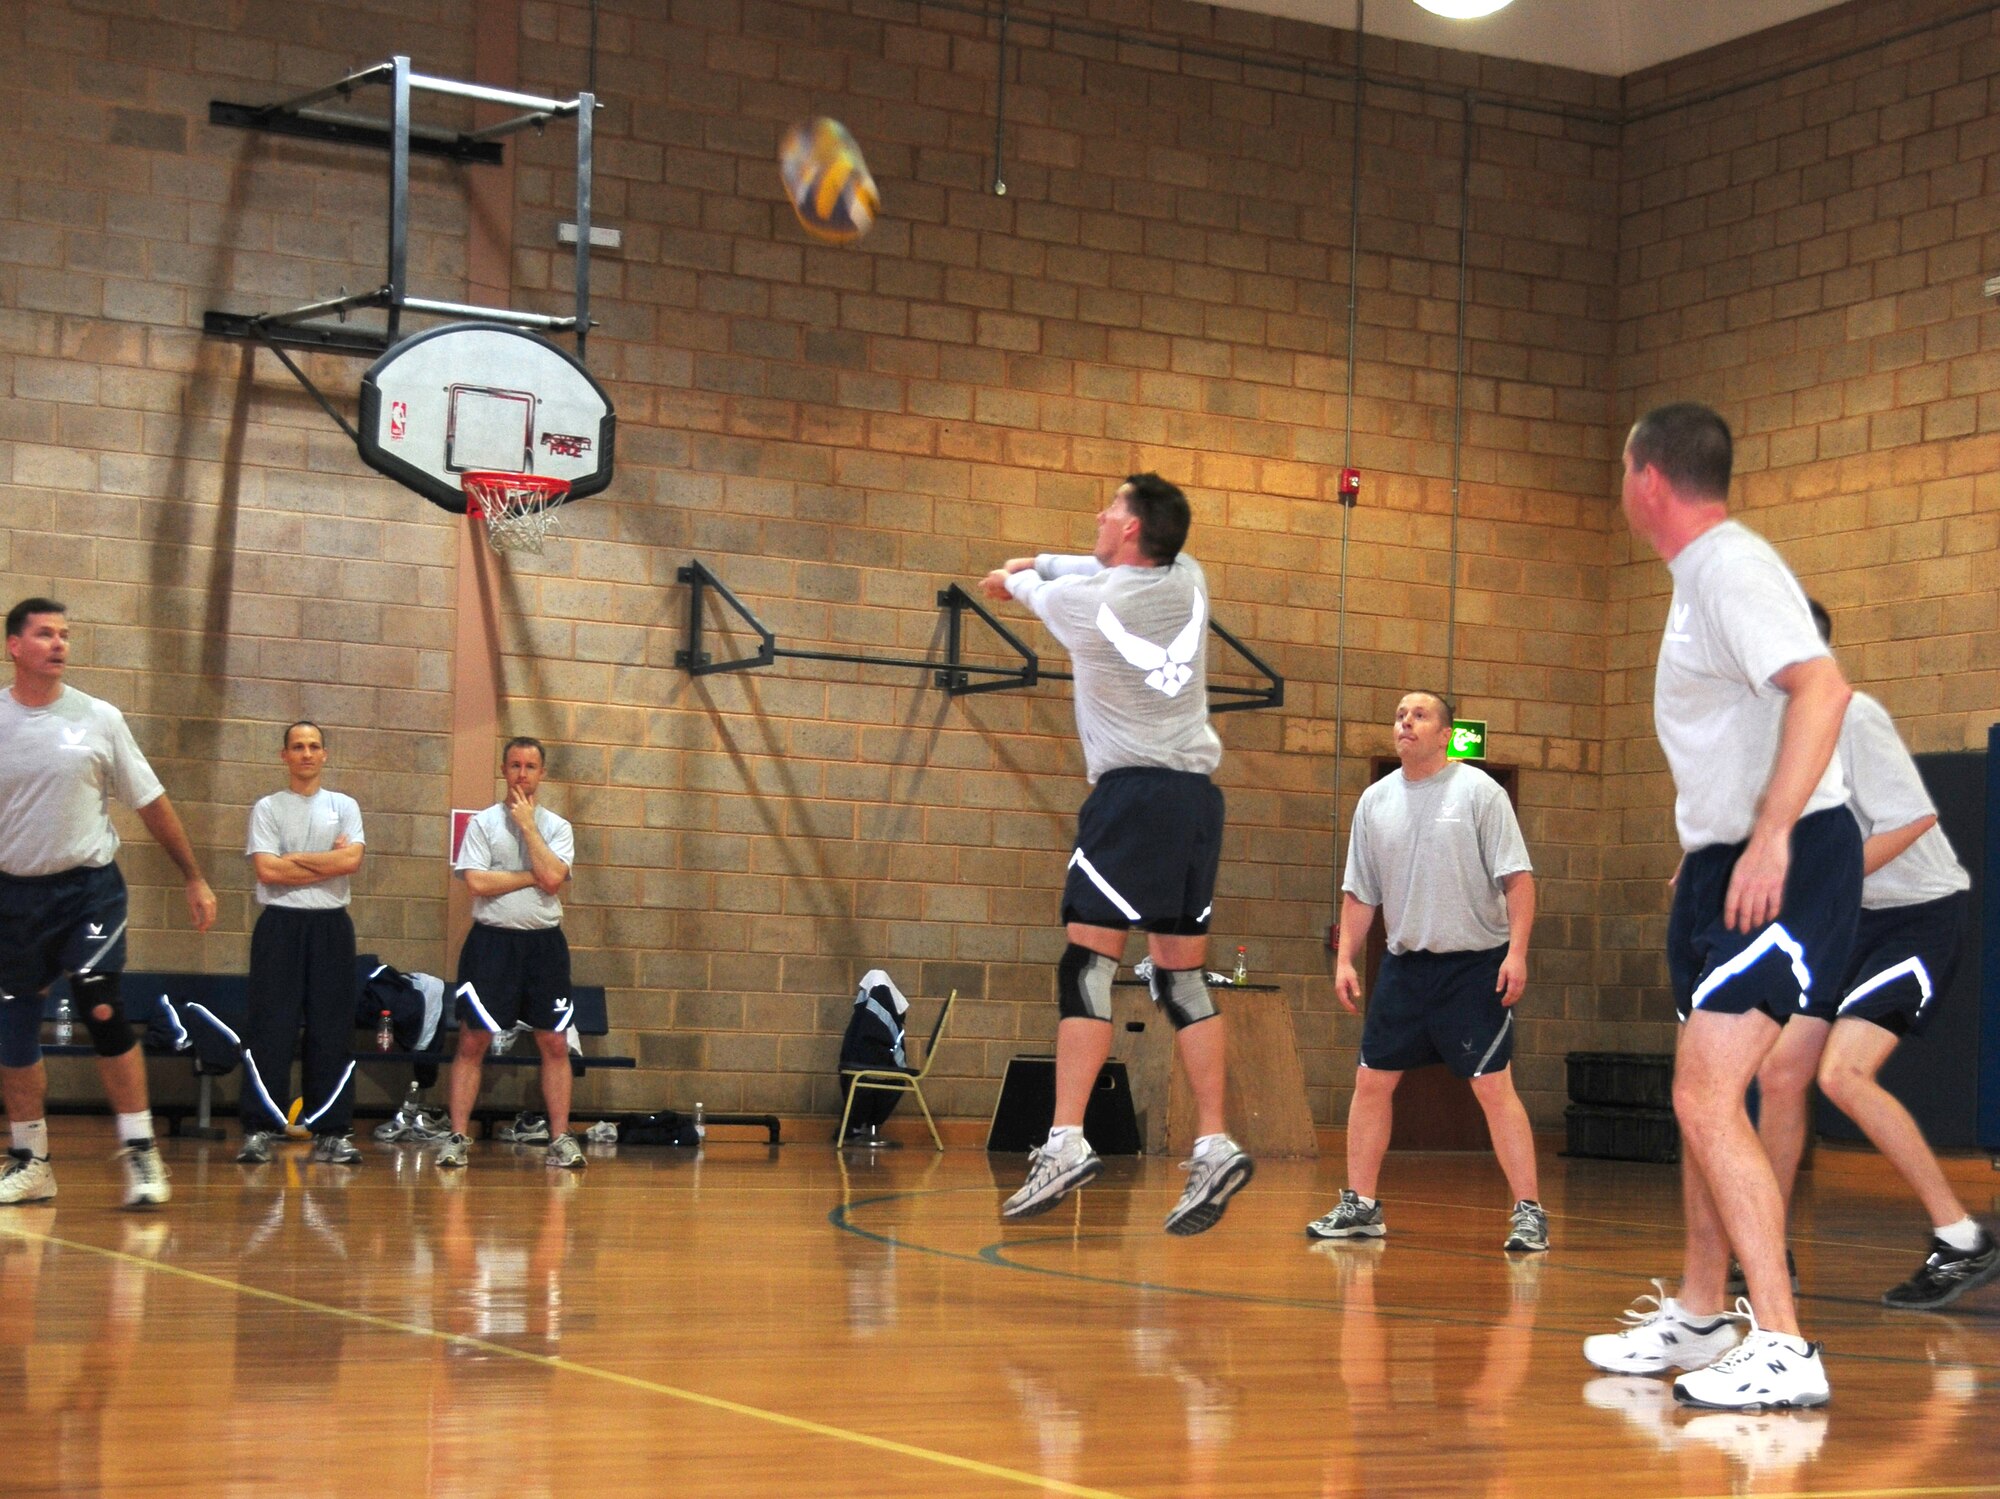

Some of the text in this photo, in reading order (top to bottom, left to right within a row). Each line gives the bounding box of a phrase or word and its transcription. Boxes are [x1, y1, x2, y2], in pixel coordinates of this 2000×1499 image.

[540, 432, 592, 451] POWER
[1659, 1331, 1679, 1345] N
[1767, 1359, 1787, 1374] N
